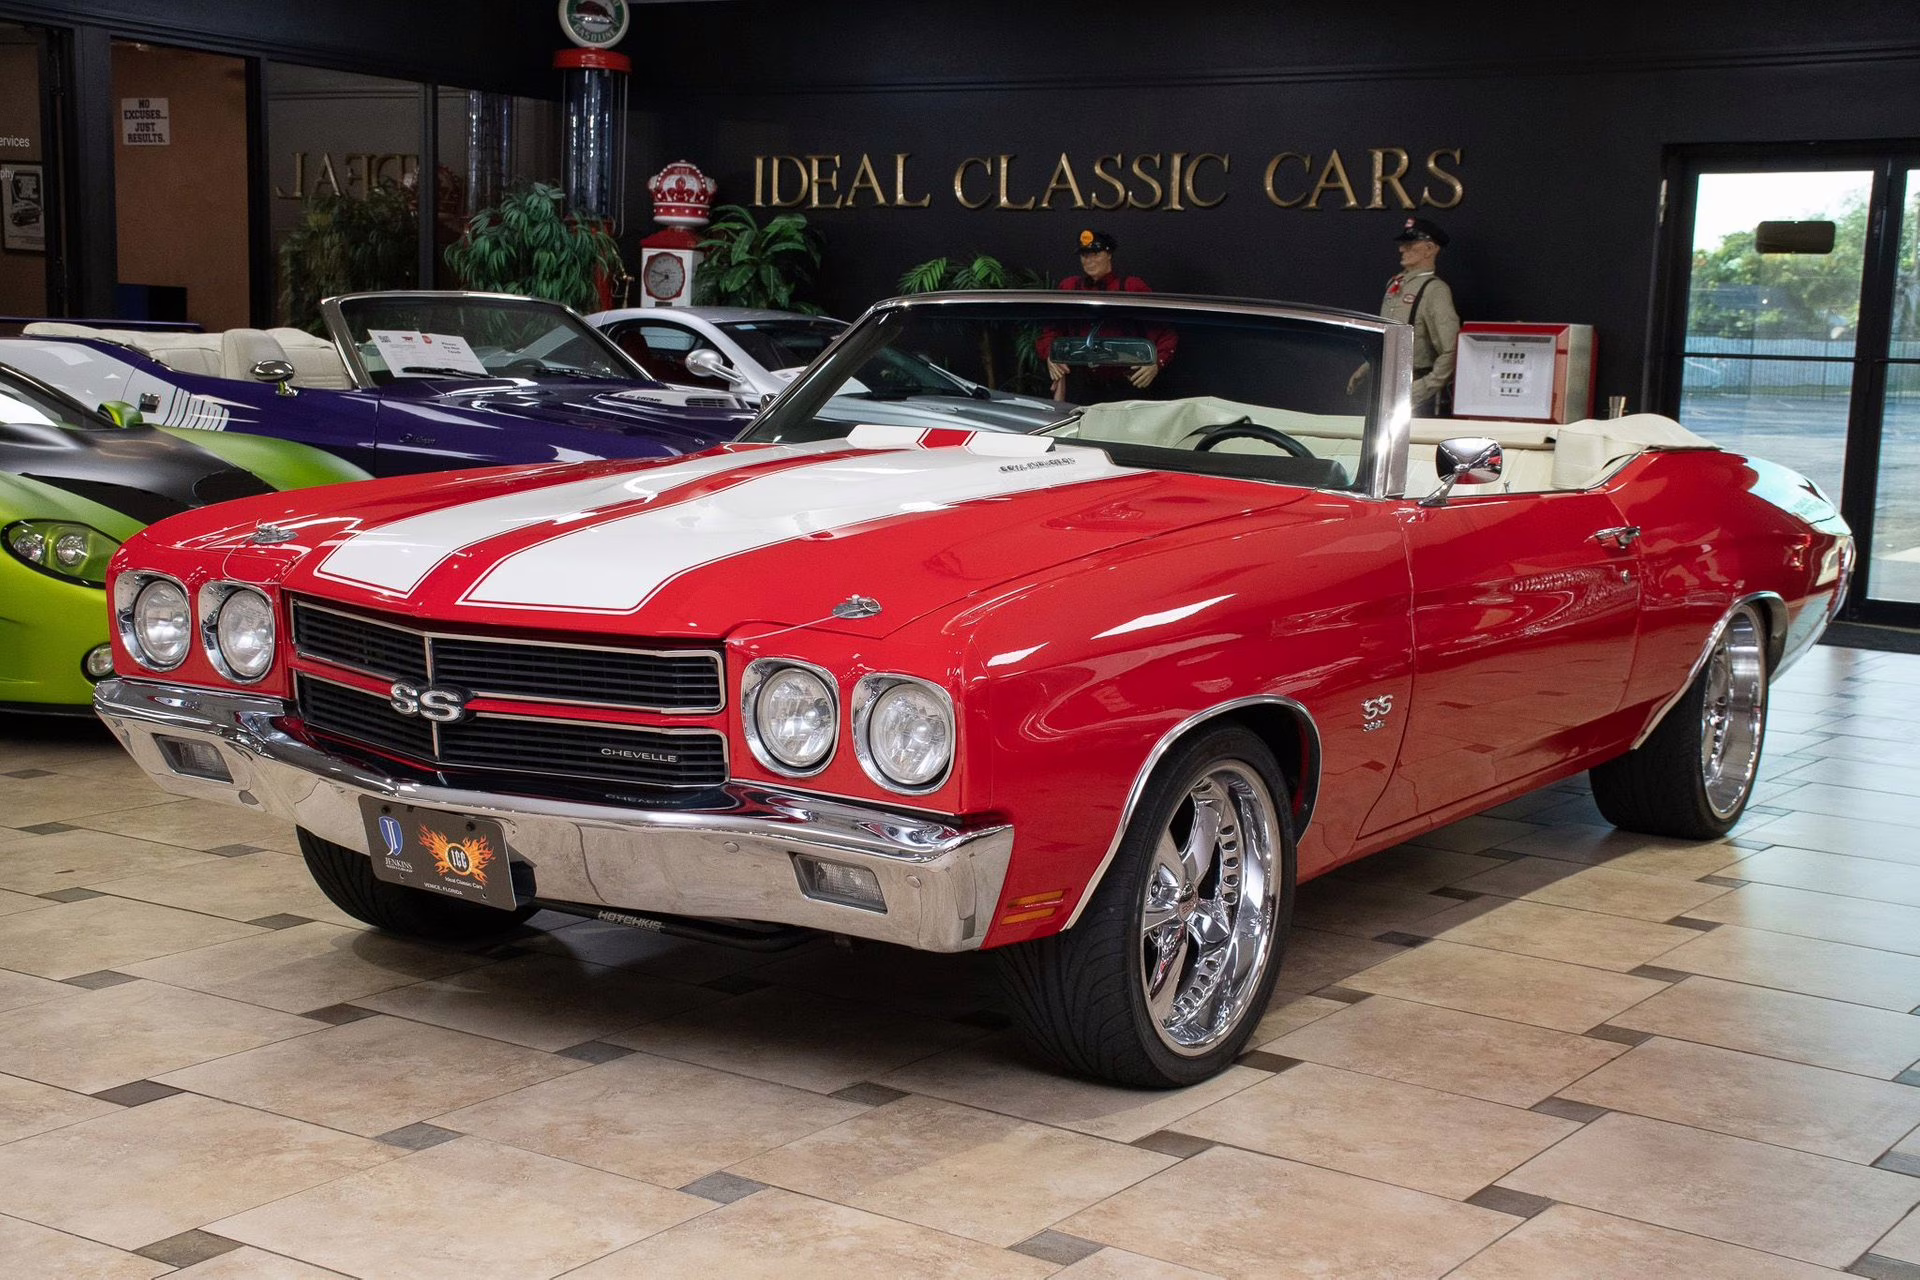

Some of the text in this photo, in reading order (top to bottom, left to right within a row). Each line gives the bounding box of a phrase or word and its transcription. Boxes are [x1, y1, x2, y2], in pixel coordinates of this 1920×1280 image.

[573, 24, 618, 42] GASOLINE
[138, 99, 150, 109] NO
[135, 122, 156, 132] JUST
[752, 148, 1464, 211] IDEAL CLASSIC CARS
[391, 682, 462, 722] SS
[1361, 694, 1394, 720] SS
[601, 748, 677, 763] CHEVELLE
[385, 857, 413, 869] JENKINS
[450, 849, 468, 870] ICC
[598, 910, 663, 930] HOTCHKIS
